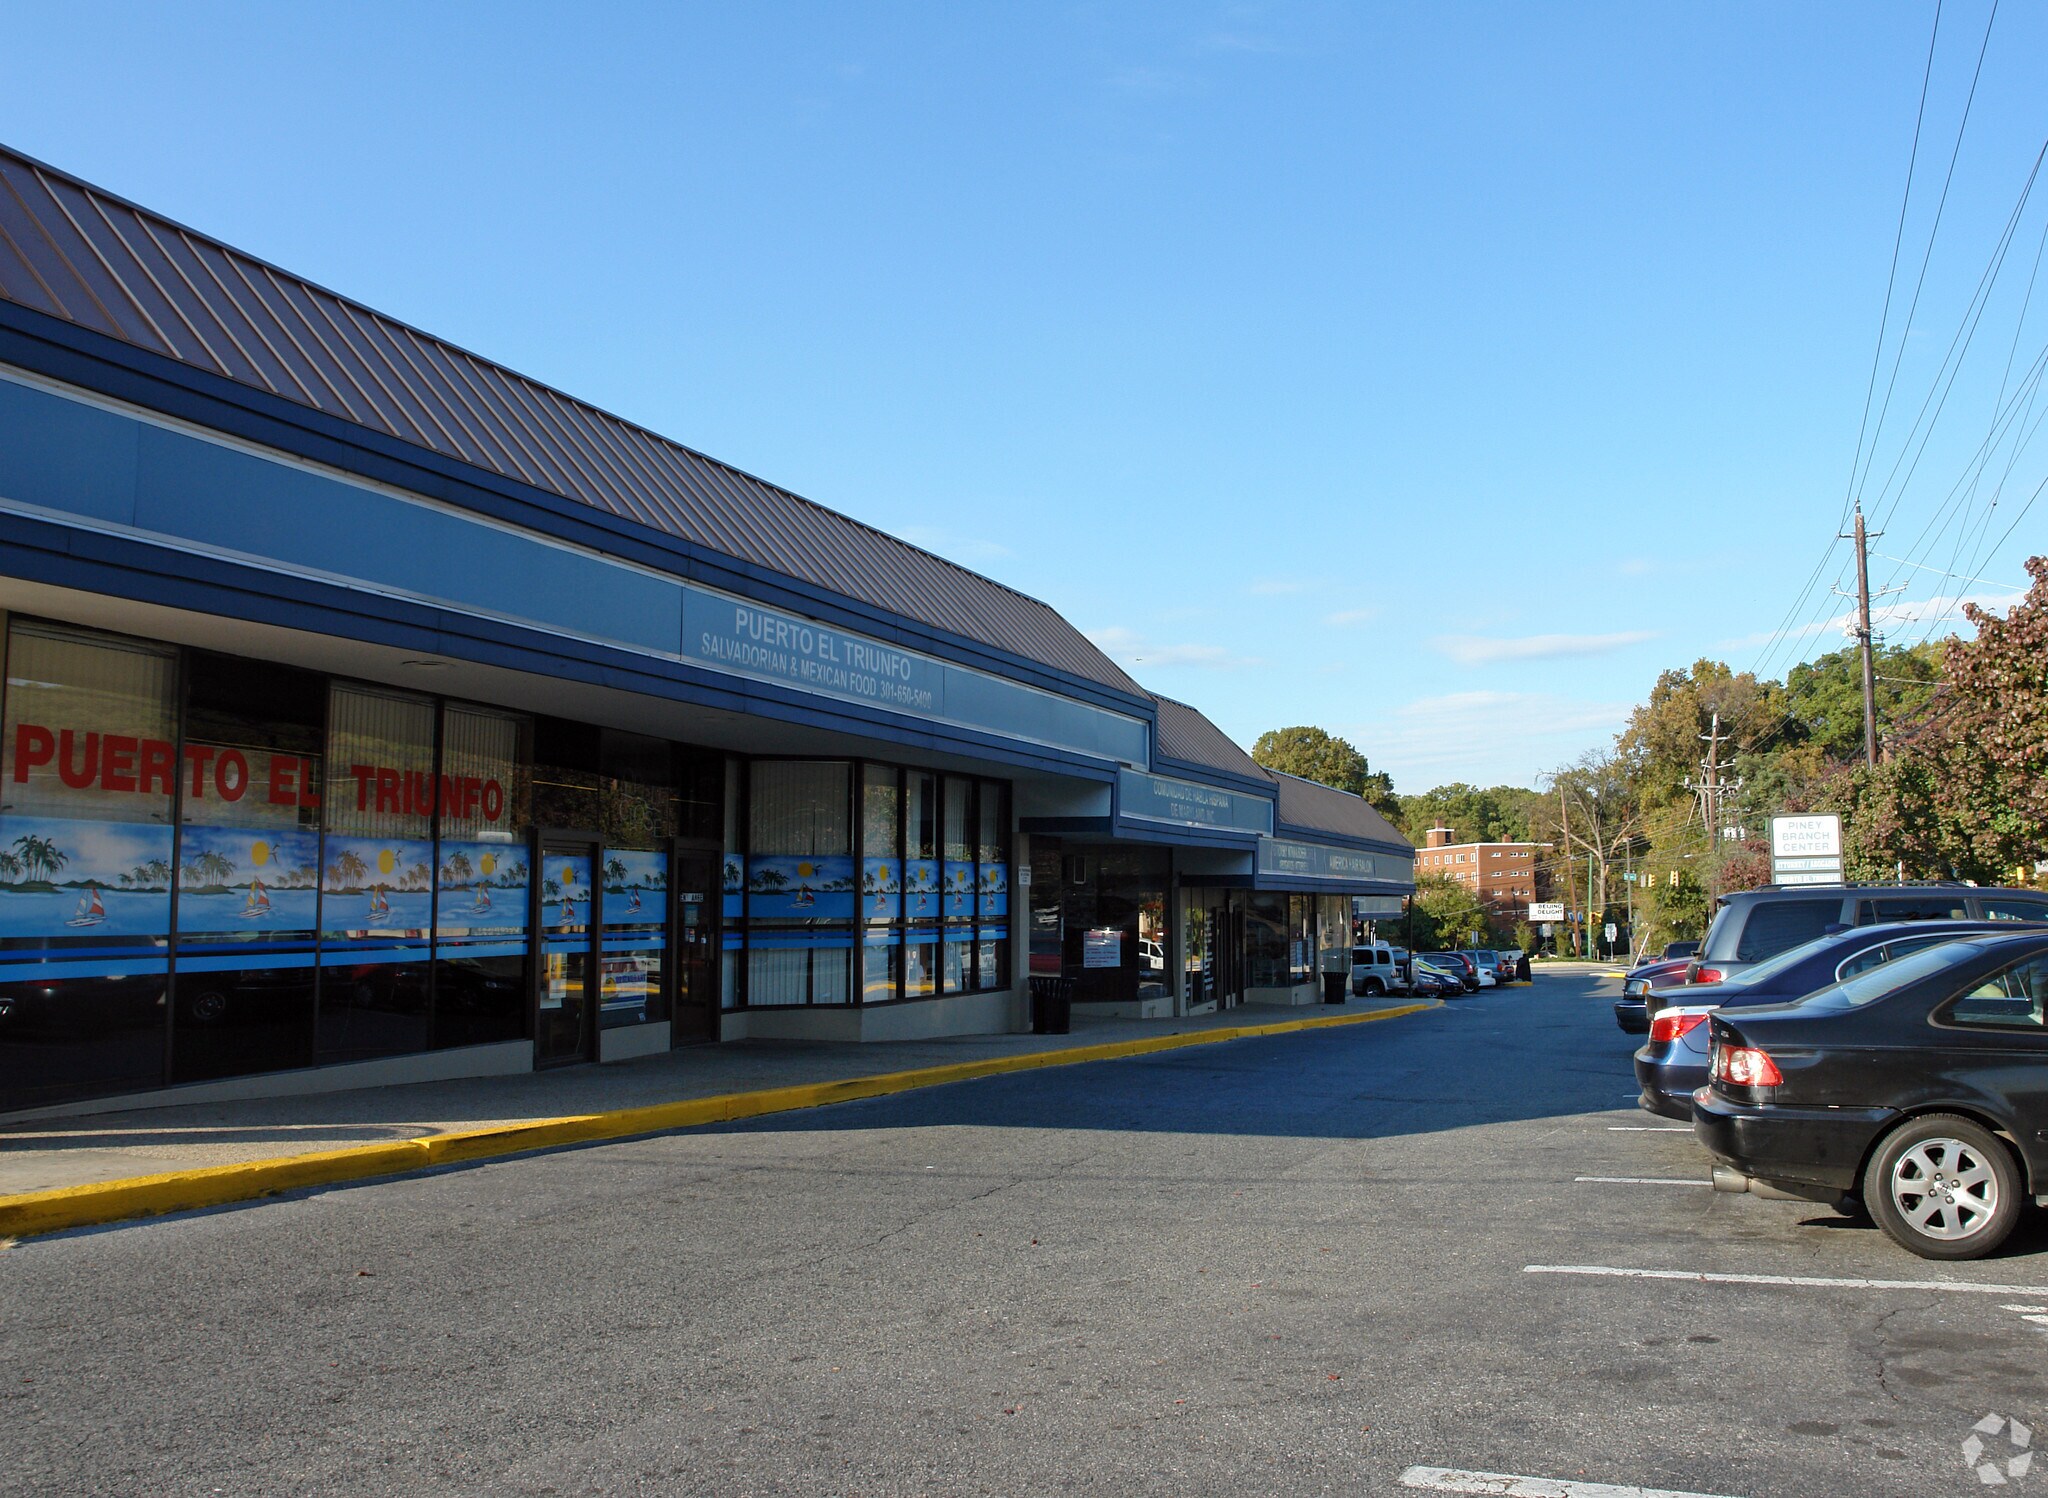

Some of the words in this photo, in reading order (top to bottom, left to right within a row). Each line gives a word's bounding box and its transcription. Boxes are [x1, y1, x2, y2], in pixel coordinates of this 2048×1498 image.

[736, 607, 814, 655] PUERTO
[818, 633, 840, 662] EL
[844, 641, 911, 681] TRIUNFO
[702, 632, 787, 674] SALVADORIAN
[789, 658, 798, 677] &
[801, 658, 847, 689] MEXICAN
[850, 672, 877, 696] FOOD
[14, 723, 249, 803] PUERTO
[268, 755, 321, 808] EL
[351, 764, 504, 822] TRIUNFO
[1782, 832, 1829, 840] BRANCH
[1788, 821, 1821, 829] PINEY
[1783, 843, 1829, 851] CENTER
